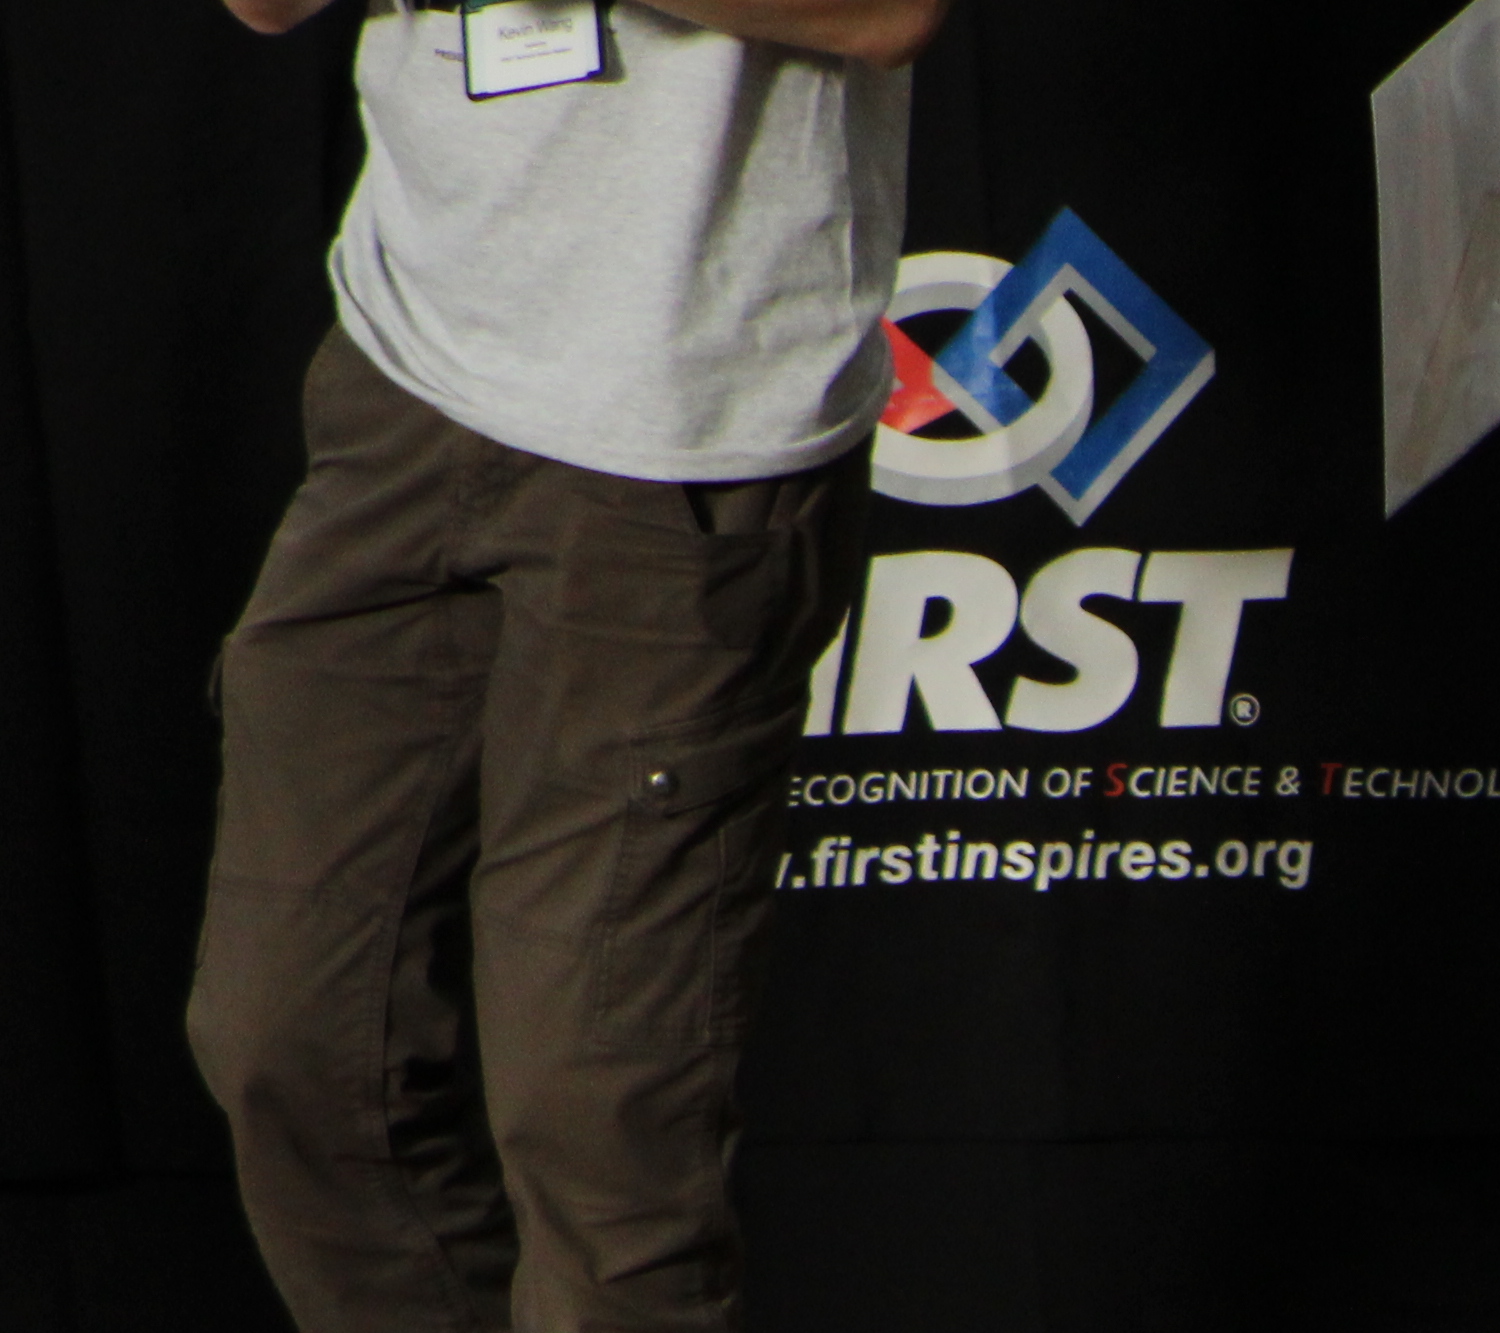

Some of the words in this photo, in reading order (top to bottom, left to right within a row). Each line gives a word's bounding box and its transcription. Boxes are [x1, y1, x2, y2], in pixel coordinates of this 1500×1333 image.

[802, 547, 1295, 737] IRST
[788, 766, 1030, 807] ECOGNITION
[1042, 767, 1094, 798] OF
[1104, 762, 1263, 798] SCIENCE
[1275, 765, 1302, 796] &
[774, 829, 1314, 892] .firstinspires.org
